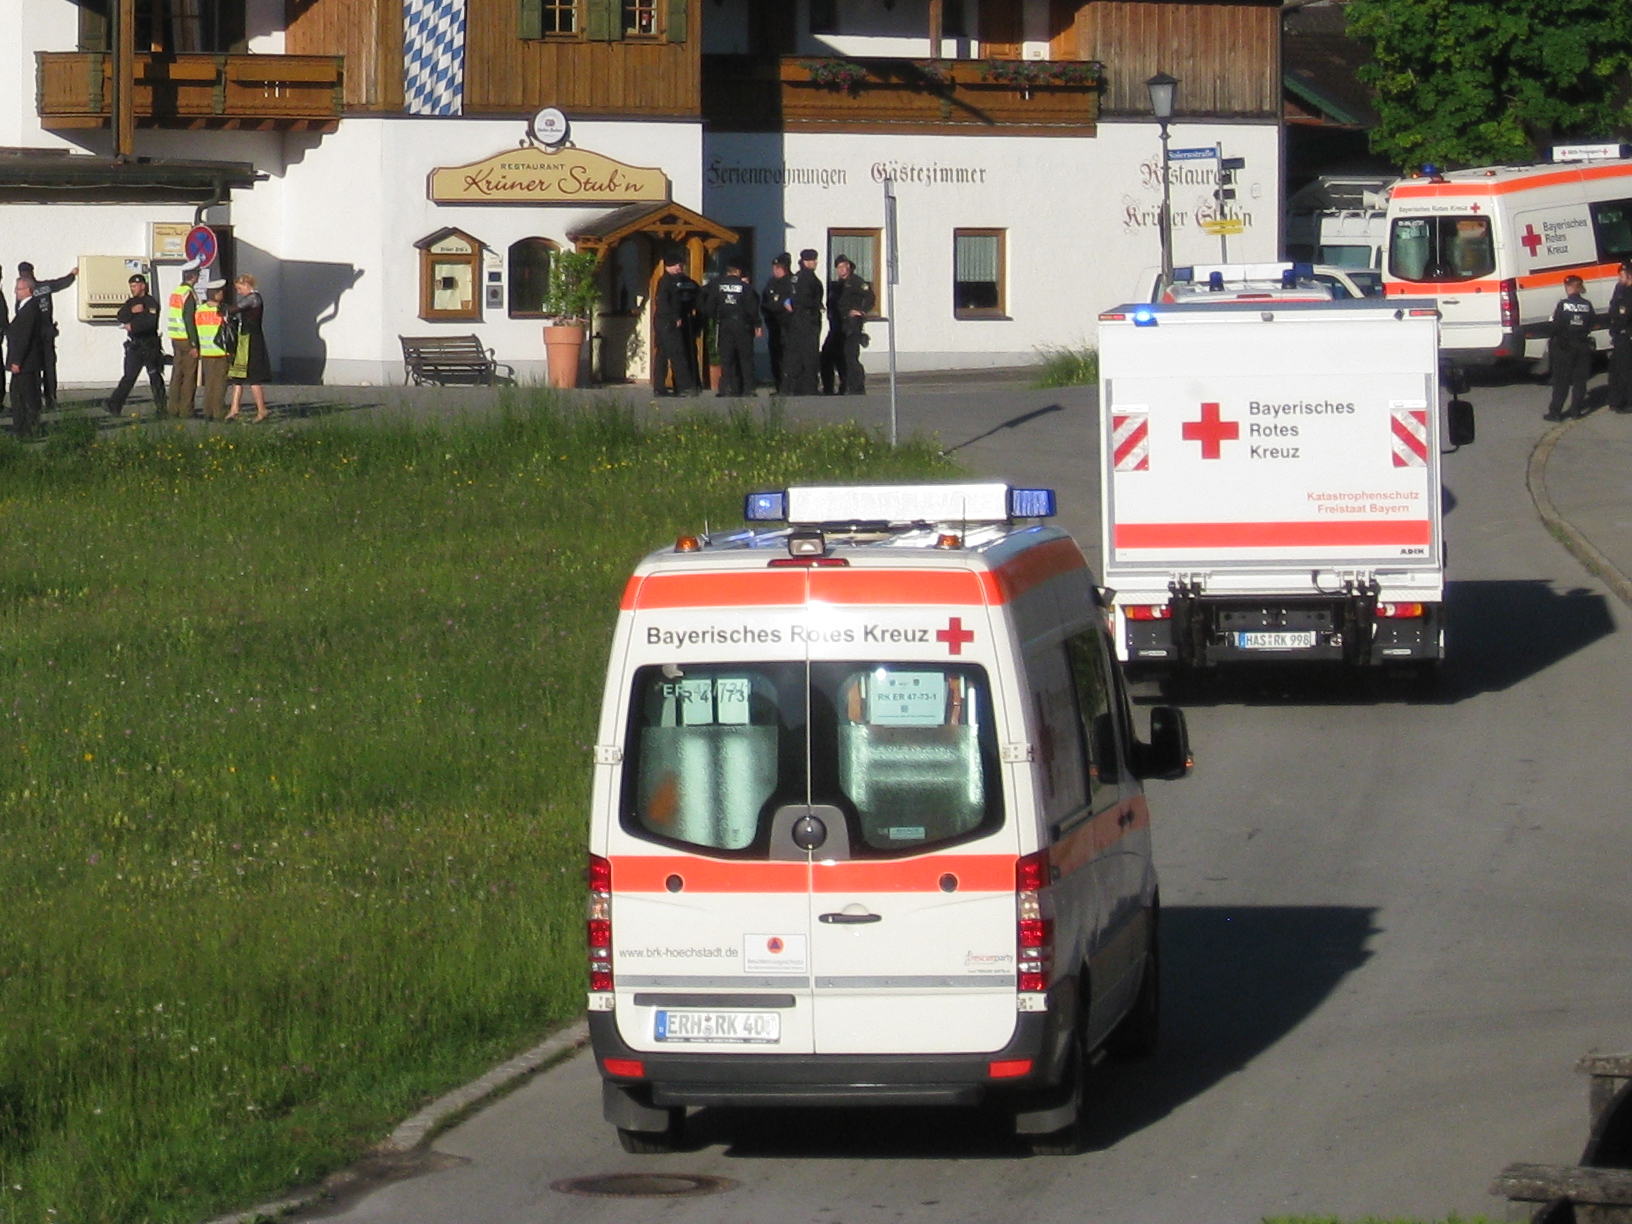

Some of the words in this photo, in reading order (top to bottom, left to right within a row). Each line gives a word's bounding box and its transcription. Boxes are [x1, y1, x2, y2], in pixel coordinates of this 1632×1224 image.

[500, 163, 566, 171] RESTAURANT
[706, 156, 847, 189] Ferienwohnungen
[870, 160, 988, 186] Gästezimmer
[463, 167, 552, 196] Krüner
[1542, 218, 1588, 234] Bayerisches
[1544, 233, 1567, 243] Rotes
[1547, 245, 1569, 255] Kreuz
[1249, 400, 1356, 419] Bayerisches
[1249, 422, 1300, 437] Rotes
[1250, 444, 1301, 459] Kreuz
[1306, 490, 1420, 503] Katastrophenschutz
[1317, 503, 1367, 514] Freistaat
[1369, 503, 1410, 515] Bayern
[647, 626, 782, 651] Bayerisches
[790, 624, 855, 644] Rotes
[863, 624, 929, 644] Kreuz
[1246, 634, 1267, 646] HAS
[1273, 634, 1288, 646] RK
[1289, 634, 1310, 646] 998
[618, 947, 739, 958] www.brk-hoechstadt.de
[668, 1014, 703, 1035] ERH
[715, 1014, 738, 1035] RK
